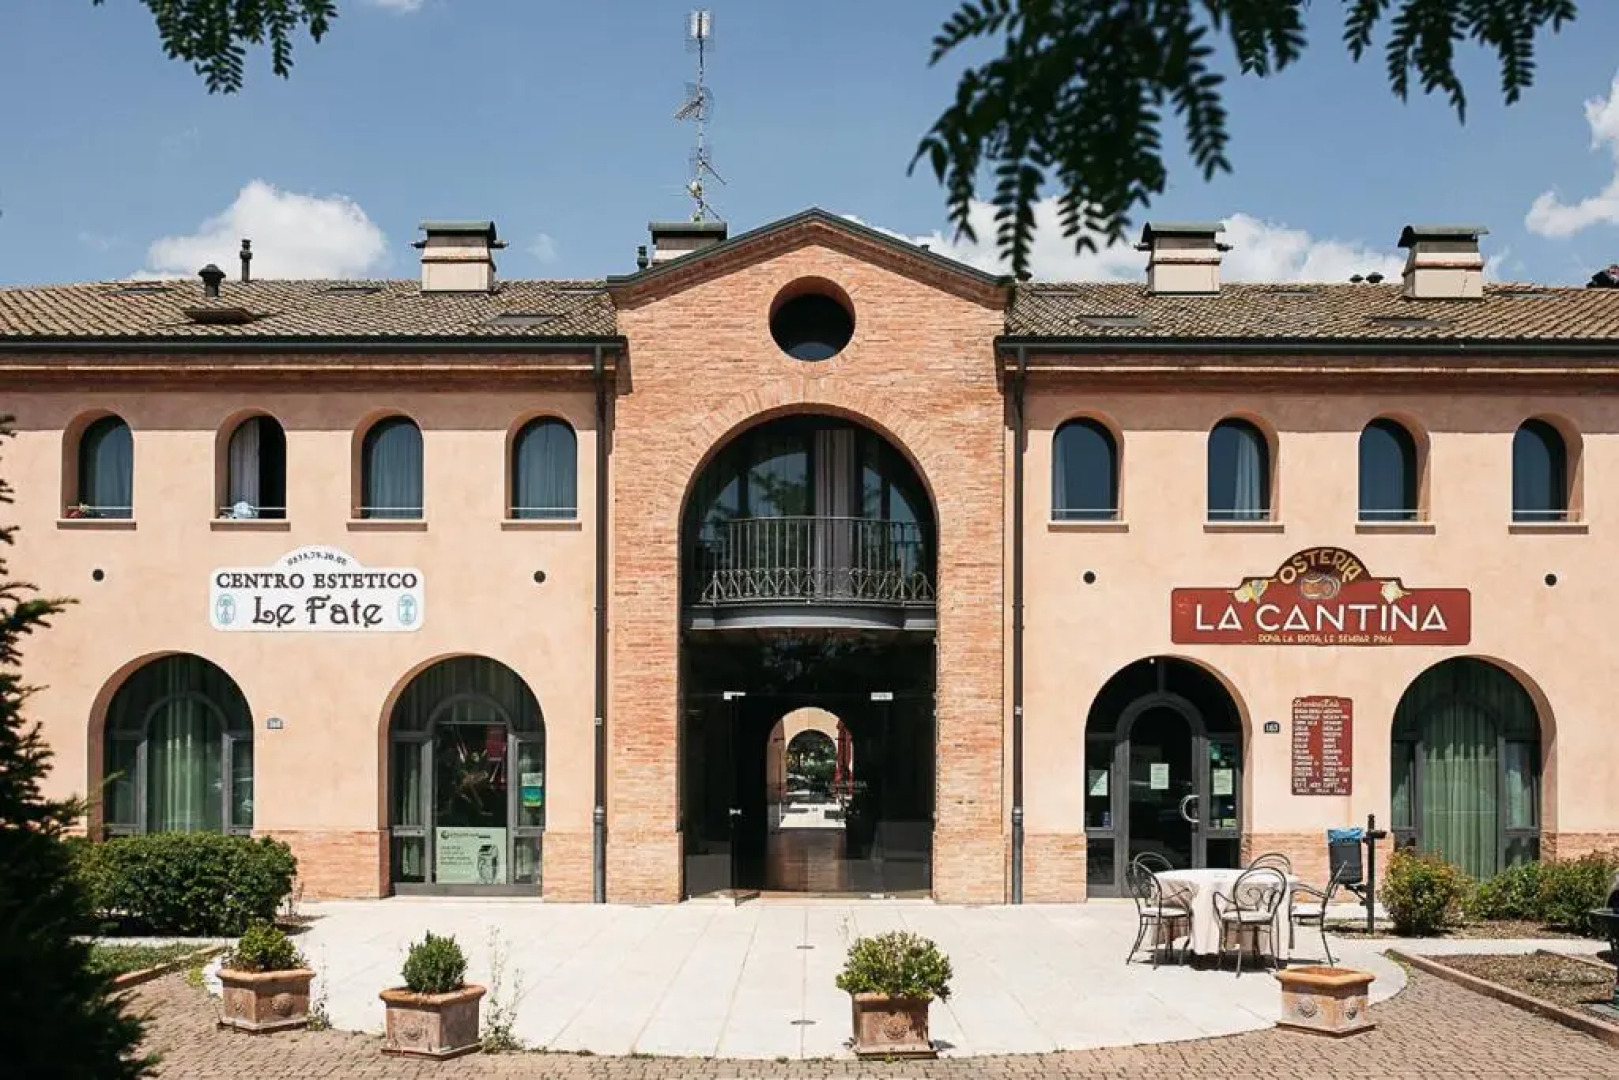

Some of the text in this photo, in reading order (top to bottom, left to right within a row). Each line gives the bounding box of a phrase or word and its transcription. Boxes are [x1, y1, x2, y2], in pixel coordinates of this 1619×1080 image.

[216, 573, 417, 588] CENTRO ESTETICO
[1279, 550, 1363, 584] OSTERIA
[252, 594, 383, 628] Le Fate
[1196, 603, 1448, 631] LA CANTINA
